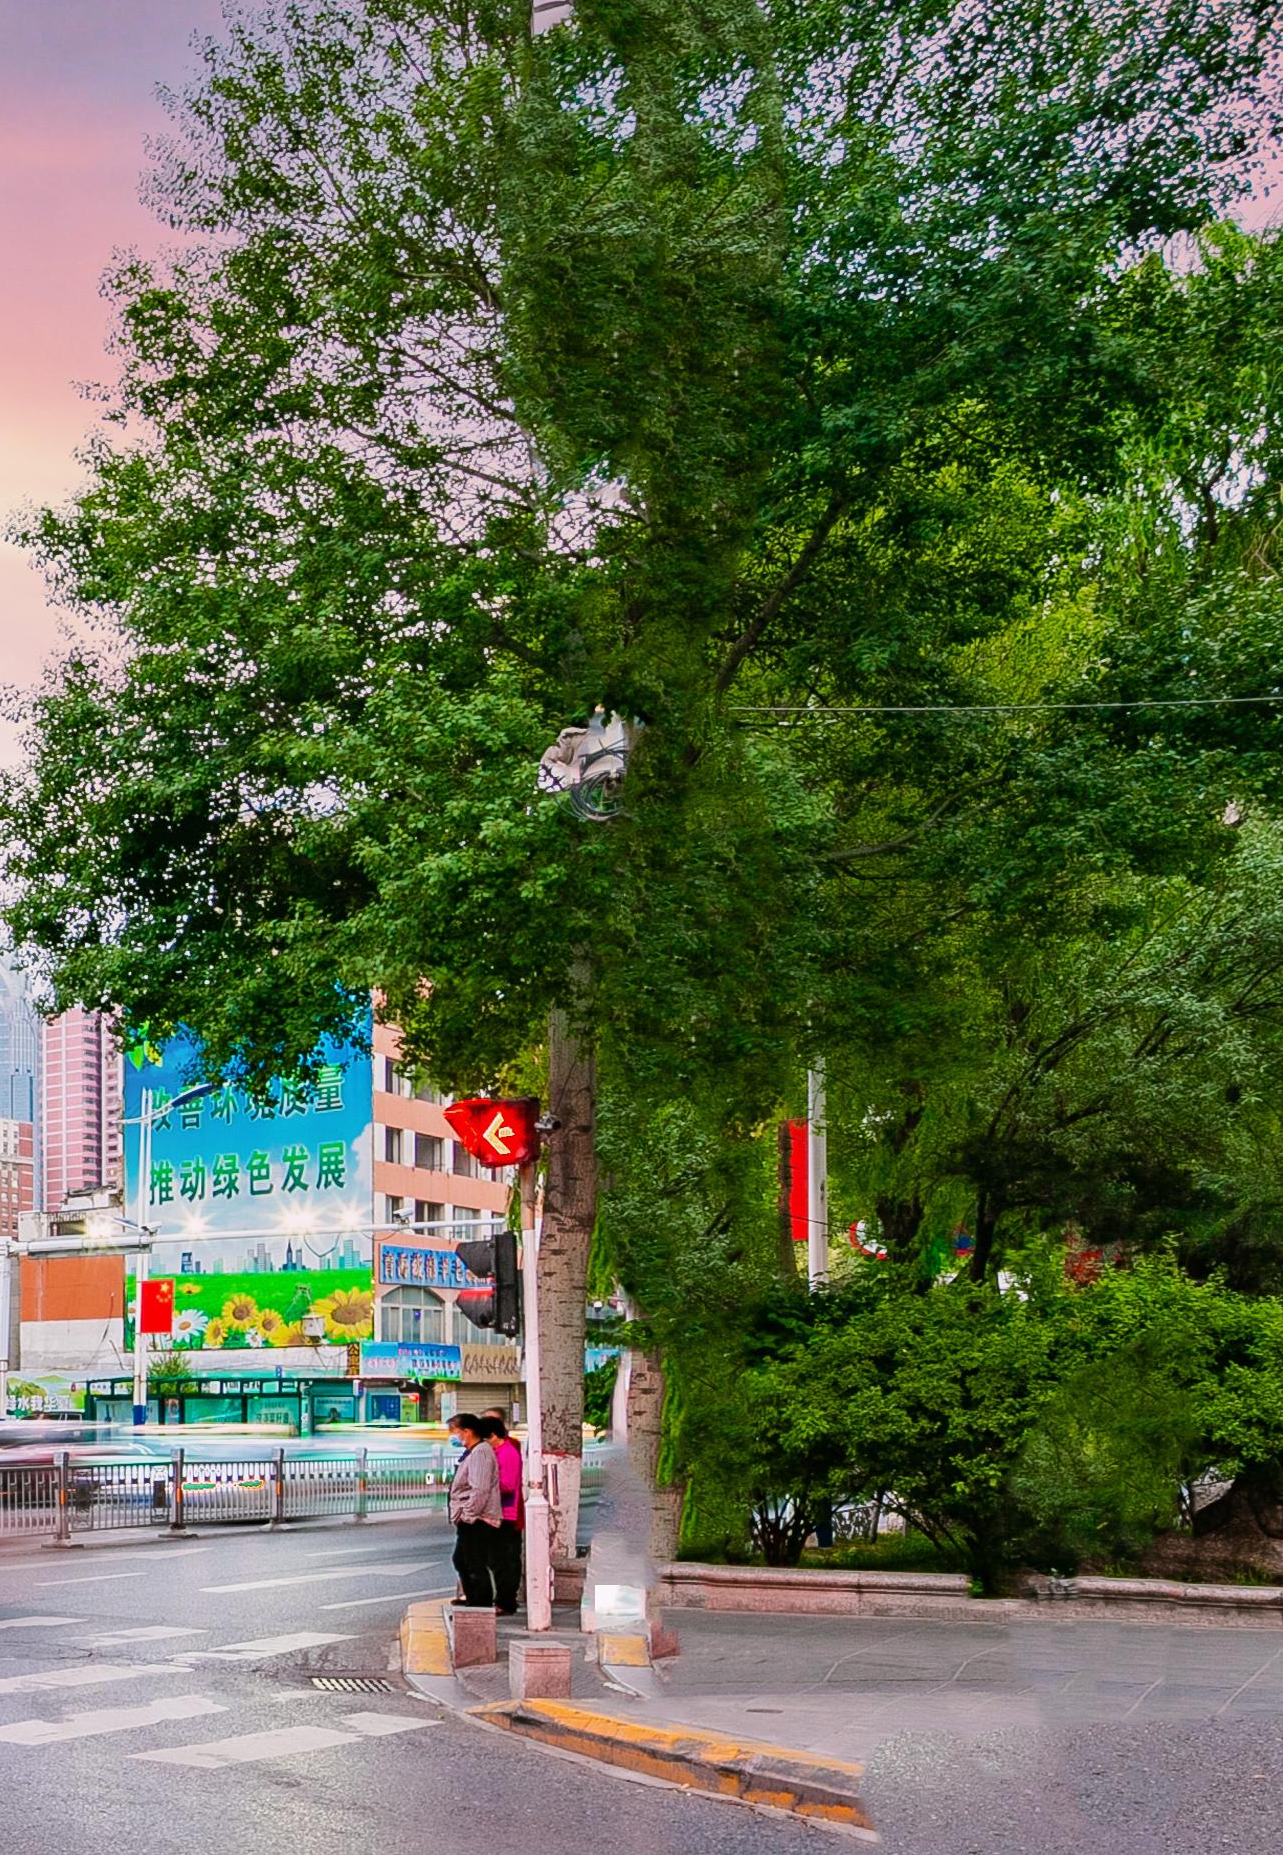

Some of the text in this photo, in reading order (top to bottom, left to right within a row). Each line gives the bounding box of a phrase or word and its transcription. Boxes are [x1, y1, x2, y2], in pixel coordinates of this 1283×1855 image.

[149, 1141, 347, 1205] 推动绿色发展
